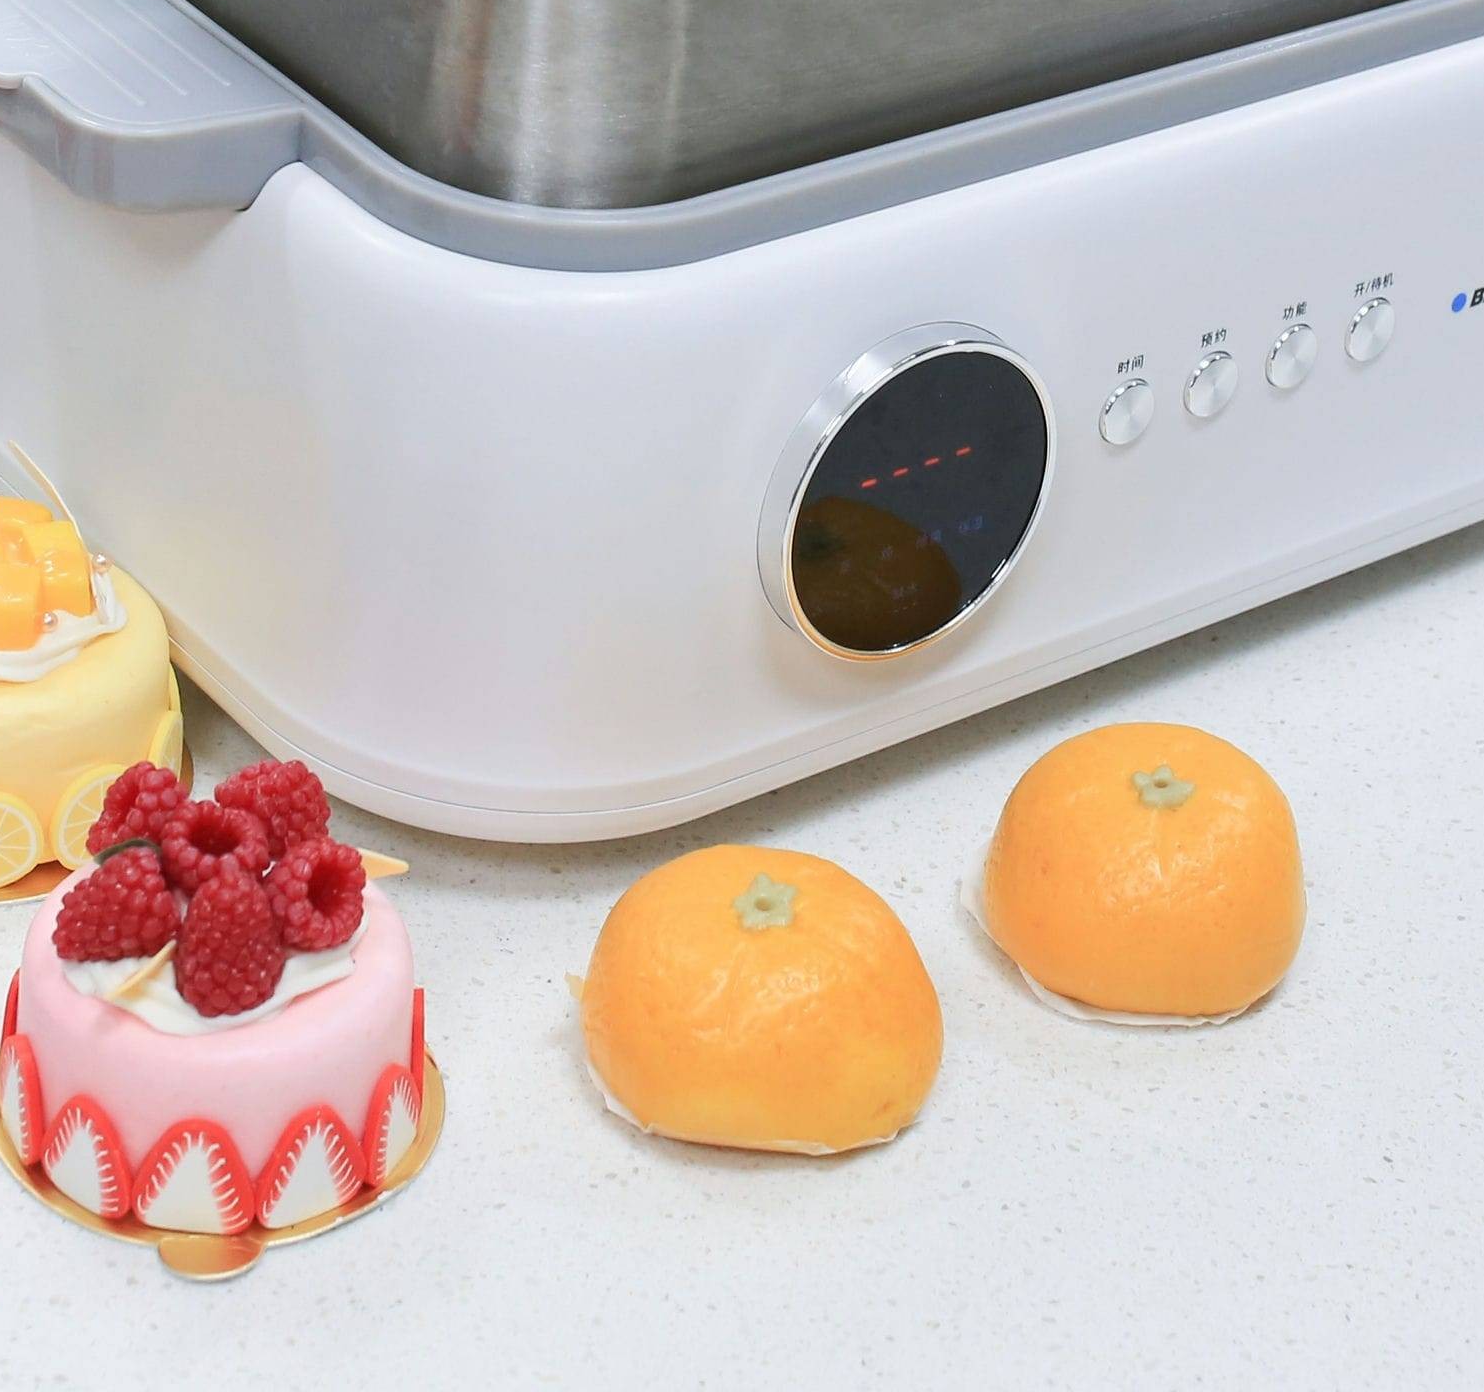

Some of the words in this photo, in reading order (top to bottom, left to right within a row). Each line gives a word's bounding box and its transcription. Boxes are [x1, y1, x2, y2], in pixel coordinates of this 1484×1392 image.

[1353, 272, 1394, 297] 开/待机
[1282, 301, 1308, 321] 功能
[1201, 327, 1228, 348] 预约
[1117, 354, 1145, 374] 时间
